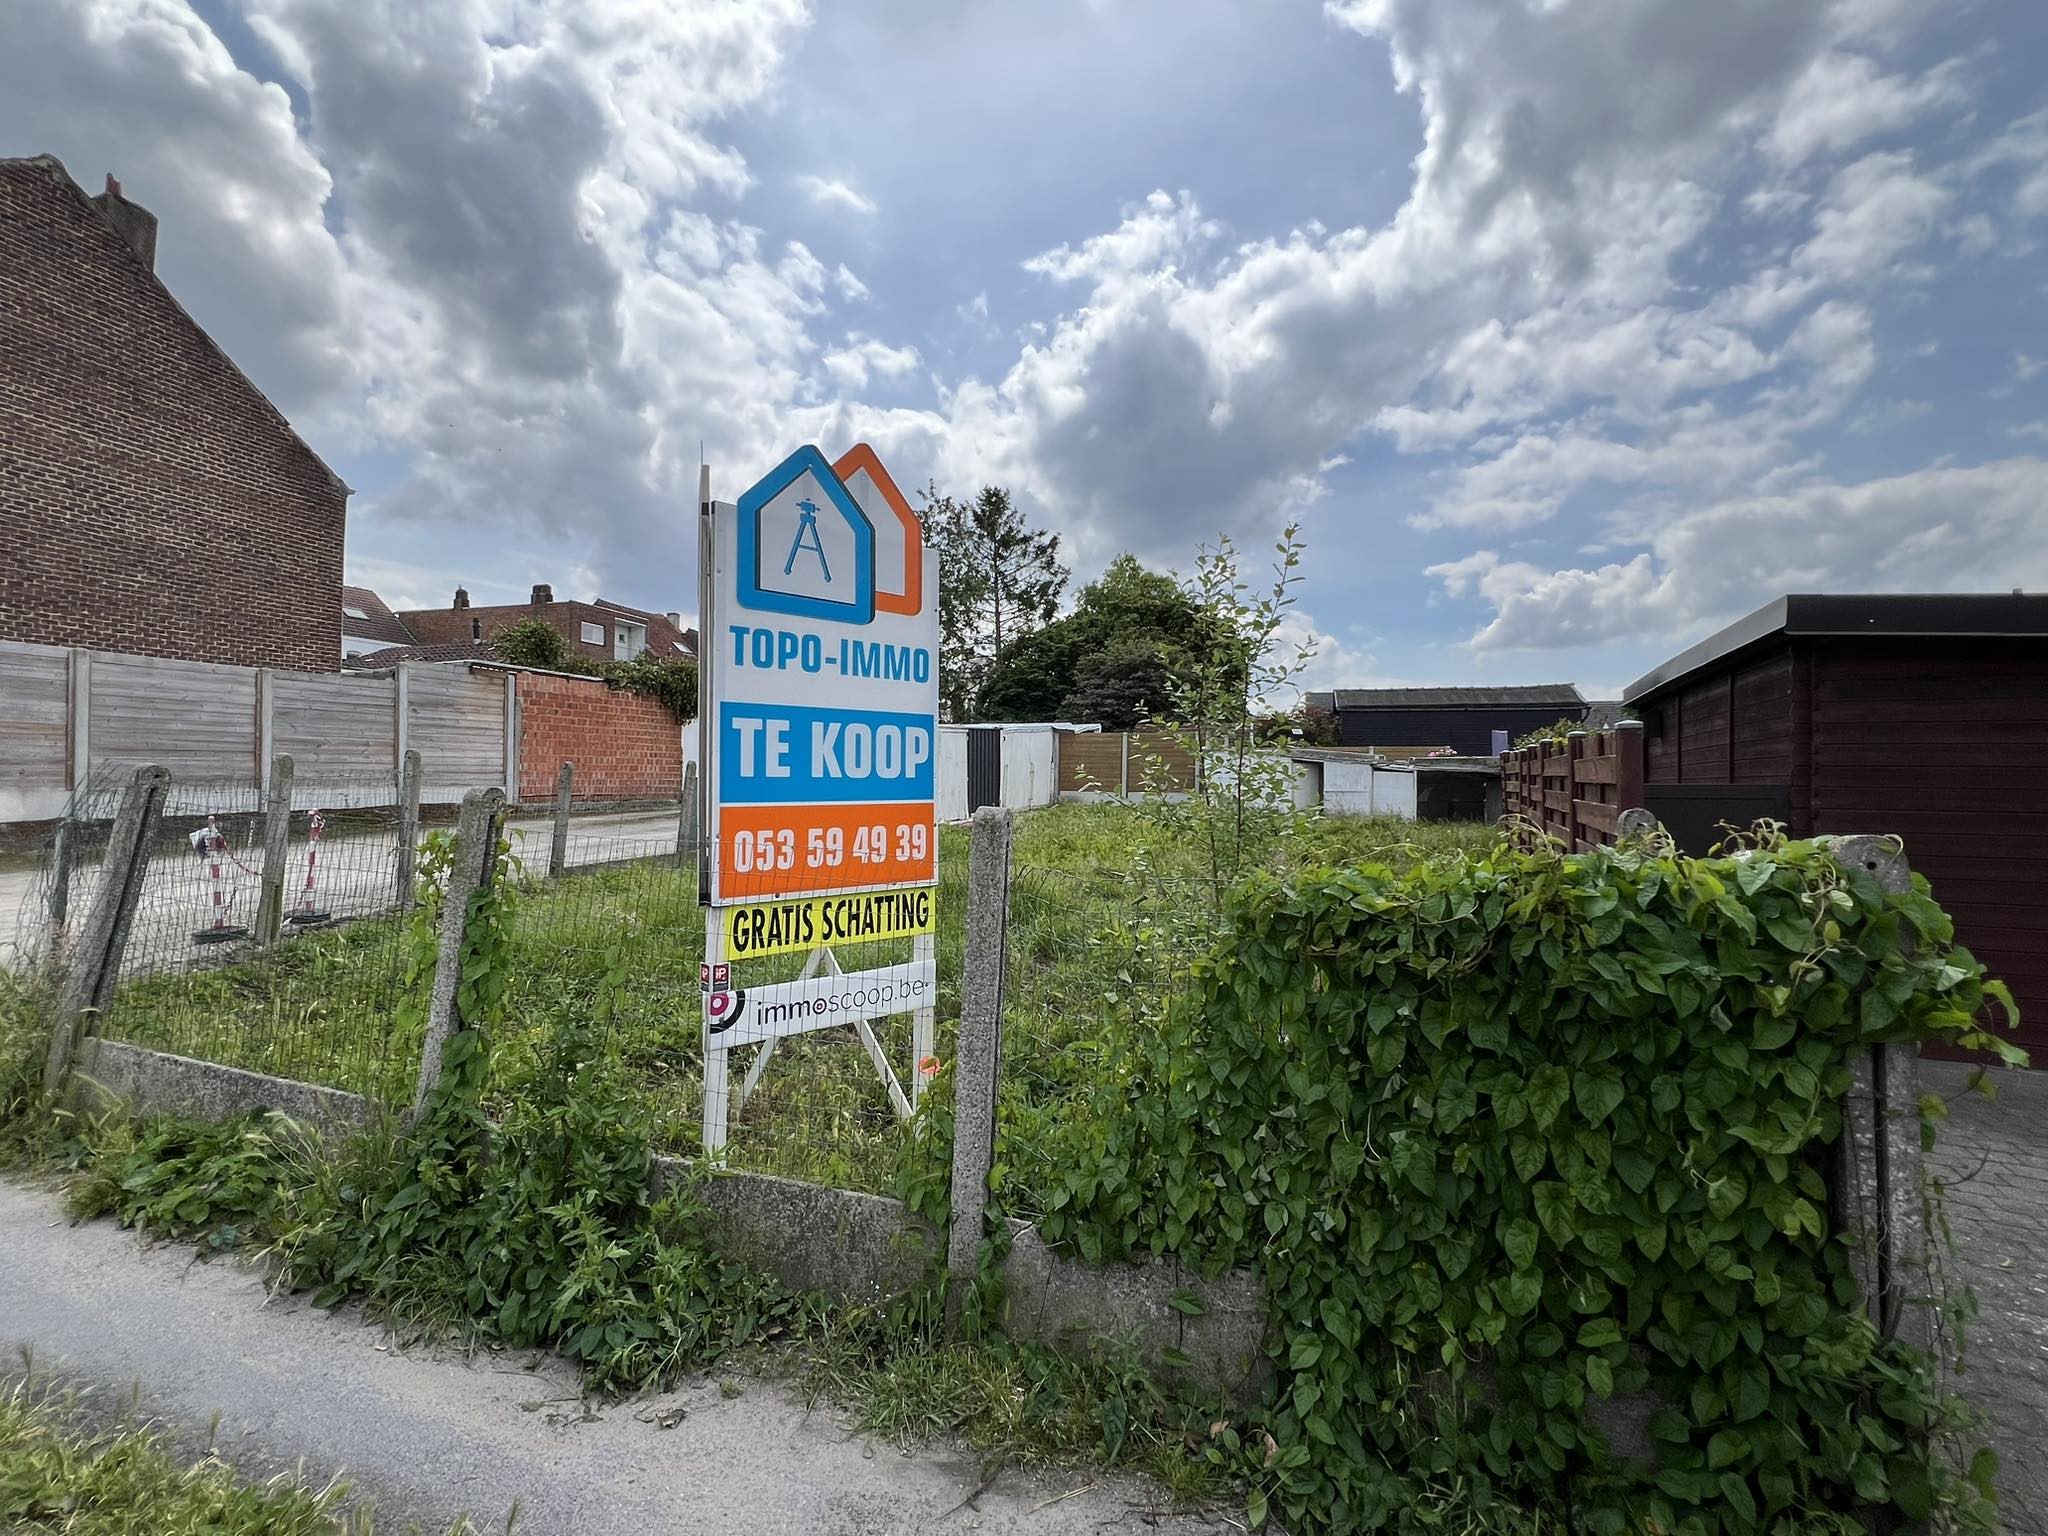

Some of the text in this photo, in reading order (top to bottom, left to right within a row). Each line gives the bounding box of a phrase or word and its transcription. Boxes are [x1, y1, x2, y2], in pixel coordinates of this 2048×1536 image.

[729, 625, 929, 683] TOPO-IMMO
[732, 717, 929, 778] TE KOOP
[734, 823, 928, 873] 053 59 49 39
[732, 891, 929, 953] GRATIS SCHATTING
[757, 978, 925, 1026] immoscoop.be
